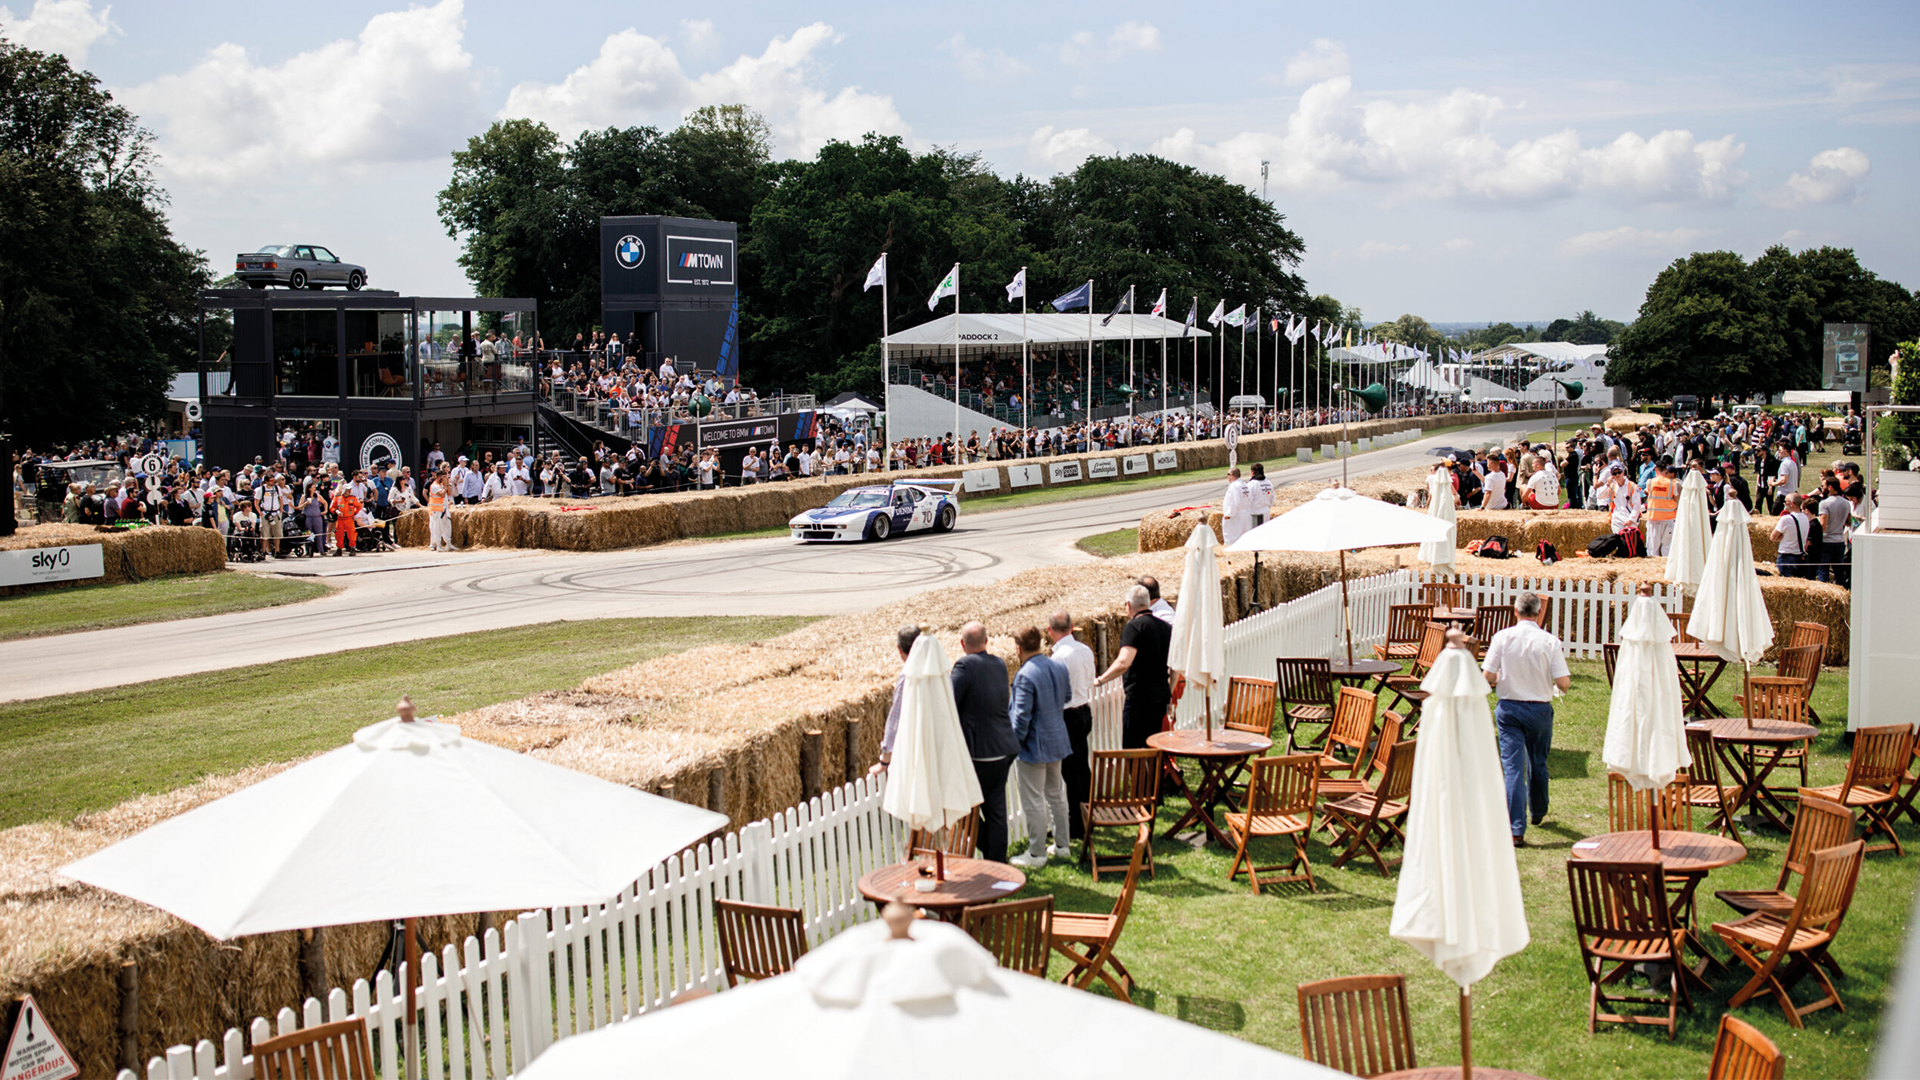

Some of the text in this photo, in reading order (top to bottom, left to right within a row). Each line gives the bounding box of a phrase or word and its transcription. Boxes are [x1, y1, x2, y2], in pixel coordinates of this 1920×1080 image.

[619, 237, 641, 247] BMW
[703, 430, 728, 442] WELCOME
[729, 429, 736, 439] TO
[736, 427, 749, 438] BMW
[149, 459, 156, 472] 6
[1063, 465, 1078, 477] sports
[895, 507, 912, 515] DENIM
[922, 511, 932, 523] 70
[32, 551, 57, 569] sky
[16, 1039, 47, 1056] WARNING
[9, 1044, 55, 1067] MOTOR SPORT
[21, 1056, 45, 1070] CAN BE
